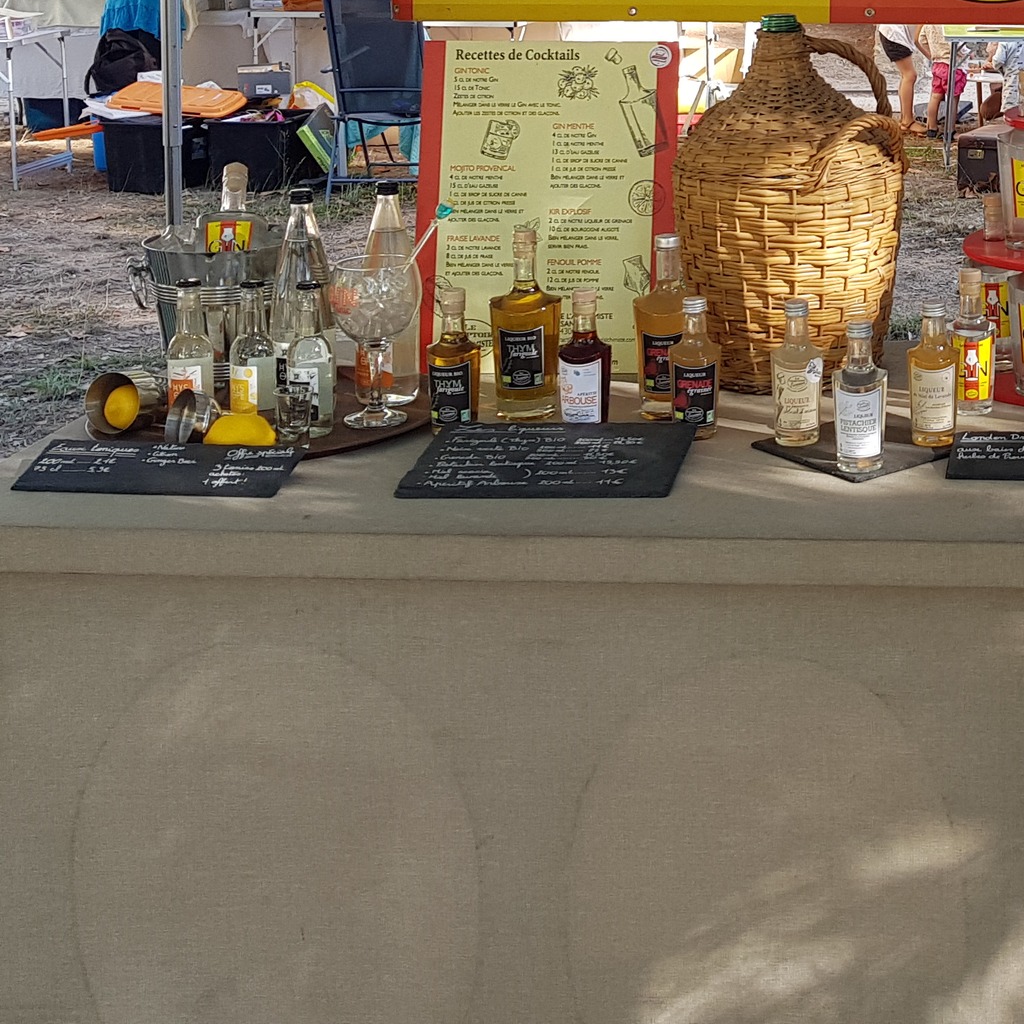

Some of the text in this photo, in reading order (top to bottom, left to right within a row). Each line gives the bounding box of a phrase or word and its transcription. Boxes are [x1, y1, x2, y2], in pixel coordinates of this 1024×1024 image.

[455, 49, 580, 61] Recettes de Cocktails
[454, 67, 490, 75] GIN TONIC
[552, 122, 595, 130] GIN MENTHE
[450, 165, 475, 173] MOJITO
[561, 208, 592, 216] EXPLOSIF
[507, 344, 535, 353] THYM
[961, 433, 1006, 441] London
